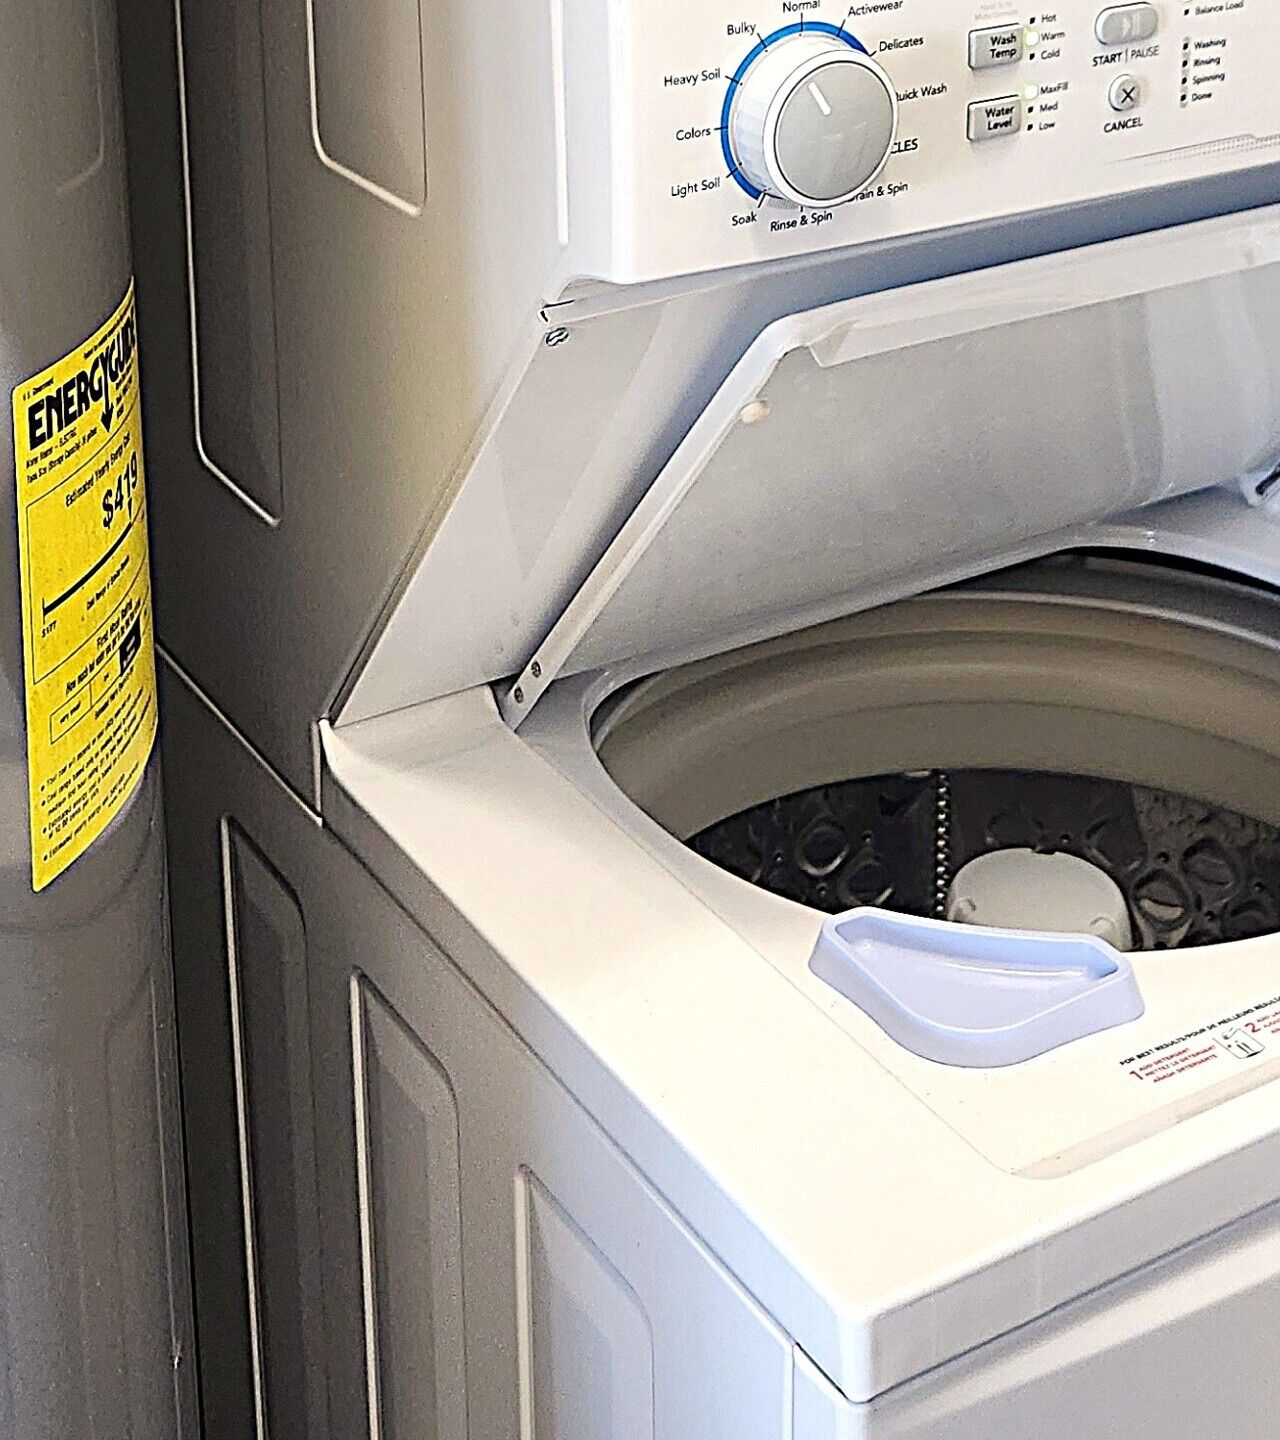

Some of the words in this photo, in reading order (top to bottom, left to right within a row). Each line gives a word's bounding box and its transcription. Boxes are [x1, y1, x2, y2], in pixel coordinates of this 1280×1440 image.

[1195, 4, 1224, 16] Balance
[1225, 0, 1245, 10] Load
[1041, 14, 1057, 23] Hot
[727, 21, 757, 37] Bulky
[990, 33, 1017, 47] Wash
[1041, 31, 1065, 42] Warm
[1194, 37, 1227, 50] Washing
[879, 35, 924, 53] Delicates
[989, 47, 1017, 60] Temp
[1040, 49, 1060, 60] Cold
[1092, 51, 1123, 67] START
[1130, 45, 1160, 60] PAUSE
[1193, 55, 1221, 68] Rinsing
[664, 73, 698, 88] Heavy
[700, 68, 721, 82] Soil
[1192, 72, 1226, 85] Spinning
[920, 82, 948, 98] Wash
[1040, 81, 1069, 94] MaxFill
[1191, 91, 1213, 102] Done
[984, 105, 1015, 118] Water
[1039, 102, 1059, 113] Med
[987, 116, 1012, 131] Level
[1038, 120, 1056, 132] Low
[1103, 117, 1144, 133] CANCEL
[675, 125, 711, 142] Colors
[670, 182, 698, 198] Light
[700, 176, 721, 191] Soil
[876, 186, 885, 197] &
[887, 182, 909, 198] Spin
[731, 211, 758, 227] Soak
[770, 217, 798, 233] Rinse
[799, 215, 809, 227] &
[810, 210, 833, 227] Spin
